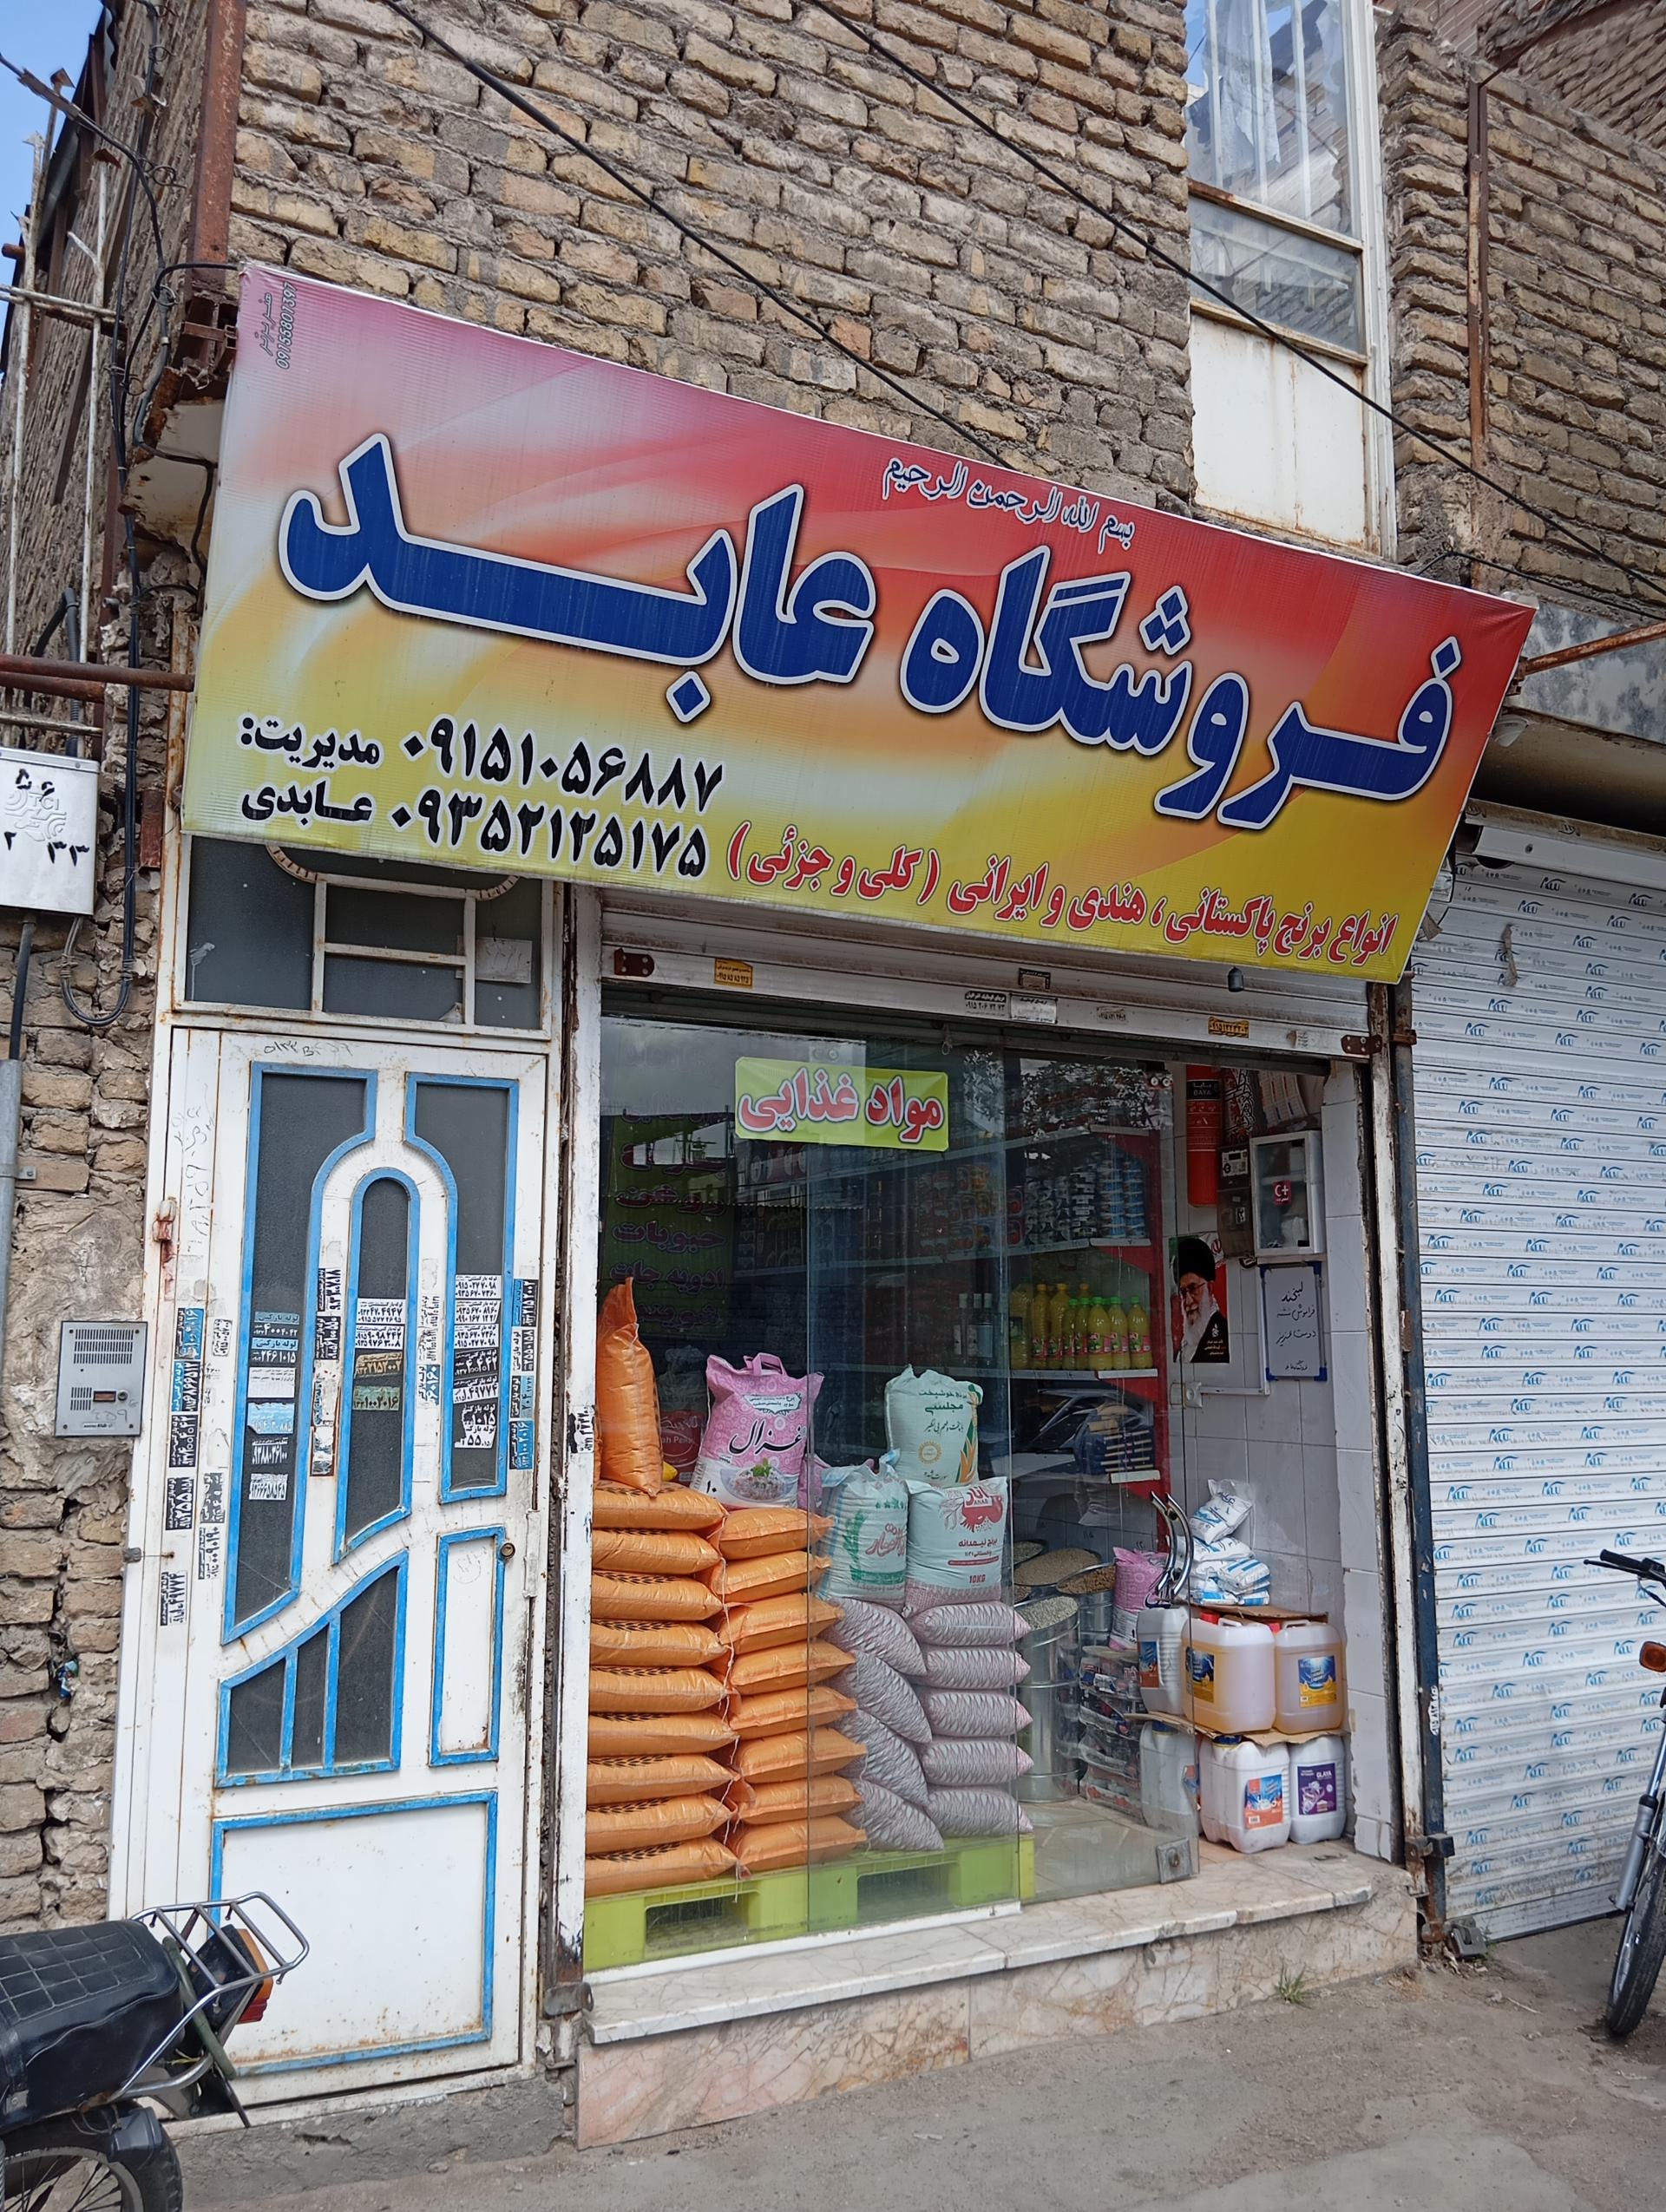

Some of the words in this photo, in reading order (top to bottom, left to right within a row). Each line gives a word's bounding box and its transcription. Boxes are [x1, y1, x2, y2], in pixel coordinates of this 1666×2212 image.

[276, 281, 298, 370] 09155801397
[967, 479, 1064, 523] الرحمن
[1061, 495, 1099, 533] الله
[1098, 515, 1135, 554] بسم
[278, 433, 876, 723] عابد
[900, 546, 1462, 831] فروشگاه
[240, 717, 380, 769] مدیریت:
[403, 717, 724, 813] ۰۹۱۵۱۰۵۶۸۸۷
[241, 780, 373, 826] عابدی
[390, 788, 706, 878] ۰۹۳۵۲۱۲۵۱۷۵
[830, 856, 856, 896] و
[948, 854, 1050, 921] ایرانی
[1040, 885, 1066, 927] و
[1067, 880, 1146, 931] هندی
[1273, 901, 1332, 959] برنج
[1328, 909, 1399, 966] انواع
[738, 1067, 859, 1132] غذایی
[865, 1076, 944, 1144] مواد
[612, 1221, 726, 1253] حبوبات
[729, 1420, 803, 1455] غزال
